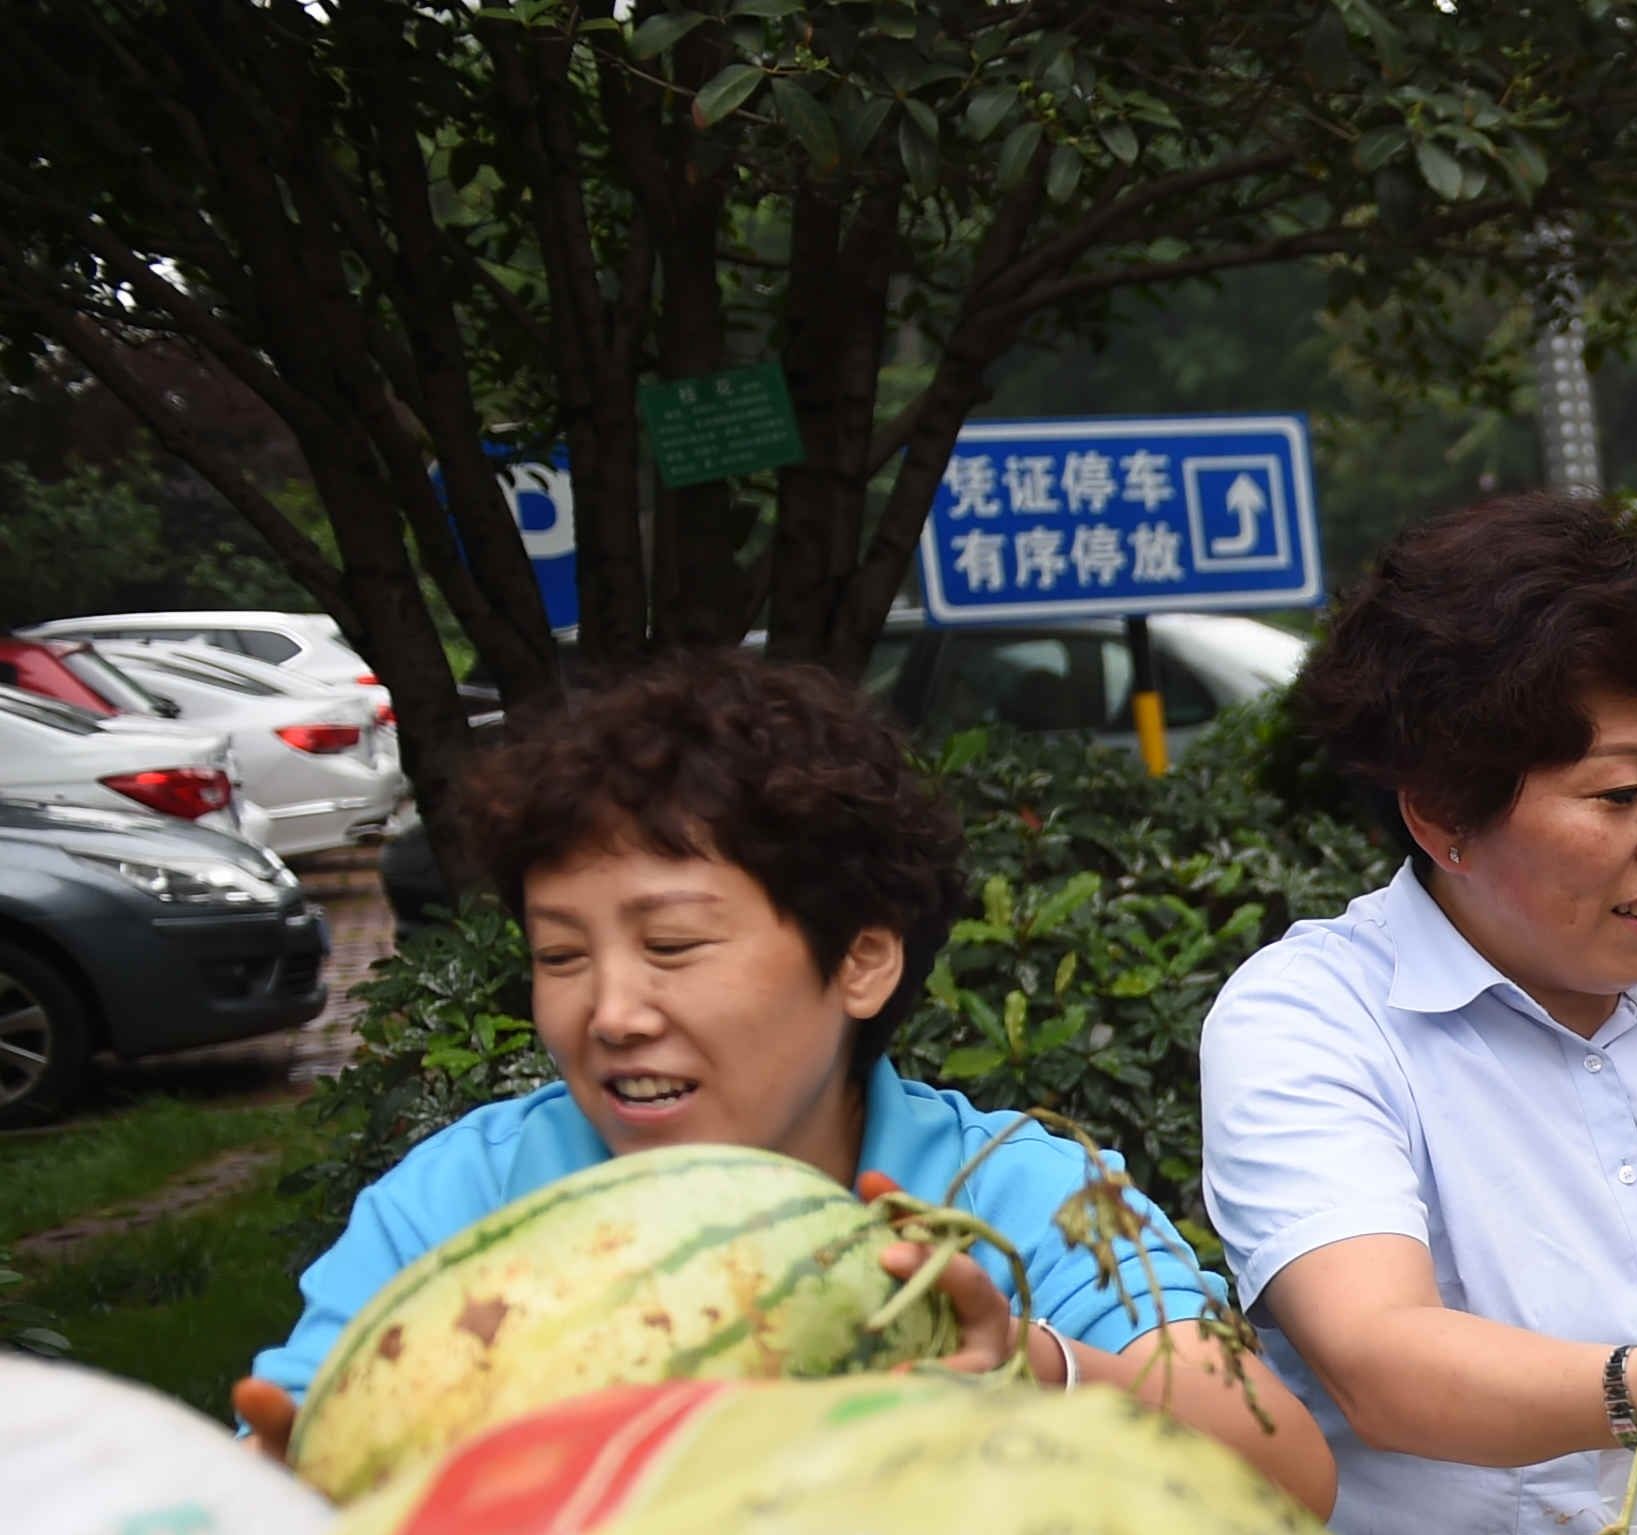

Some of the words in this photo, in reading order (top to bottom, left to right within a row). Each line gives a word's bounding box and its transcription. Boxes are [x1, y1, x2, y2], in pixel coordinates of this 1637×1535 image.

[943, 448, 1175, 519] 凭证停车
[953, 520, 1185, 594] 有序停放
